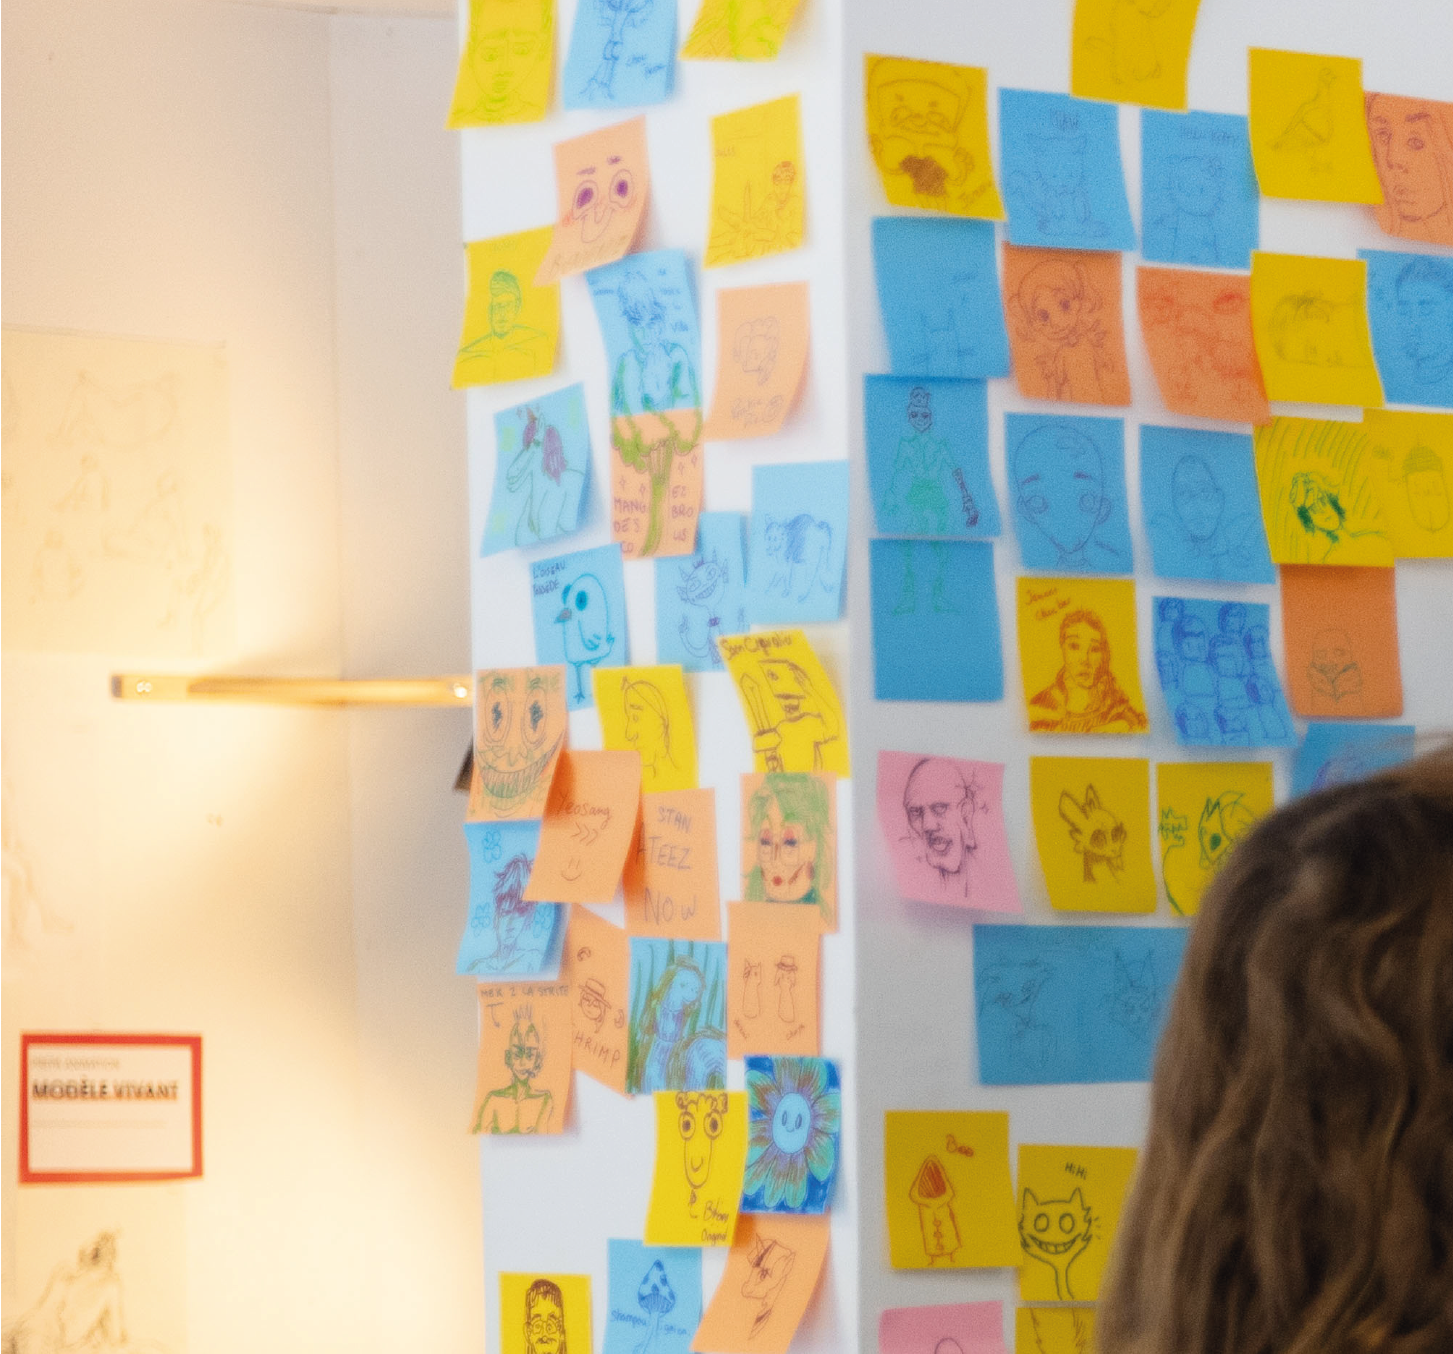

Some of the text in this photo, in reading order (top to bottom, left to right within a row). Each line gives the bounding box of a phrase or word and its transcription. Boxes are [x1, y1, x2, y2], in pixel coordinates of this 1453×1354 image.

[613, 504, 694, 534] DES BRO
[614, 498, 648, 514] MANG
[657, 805, 693, 833] STAN
[572, 1028, 621, 1069] HRIMP
[33, 1074, 178, 1100] MODÈLE VIVANT
